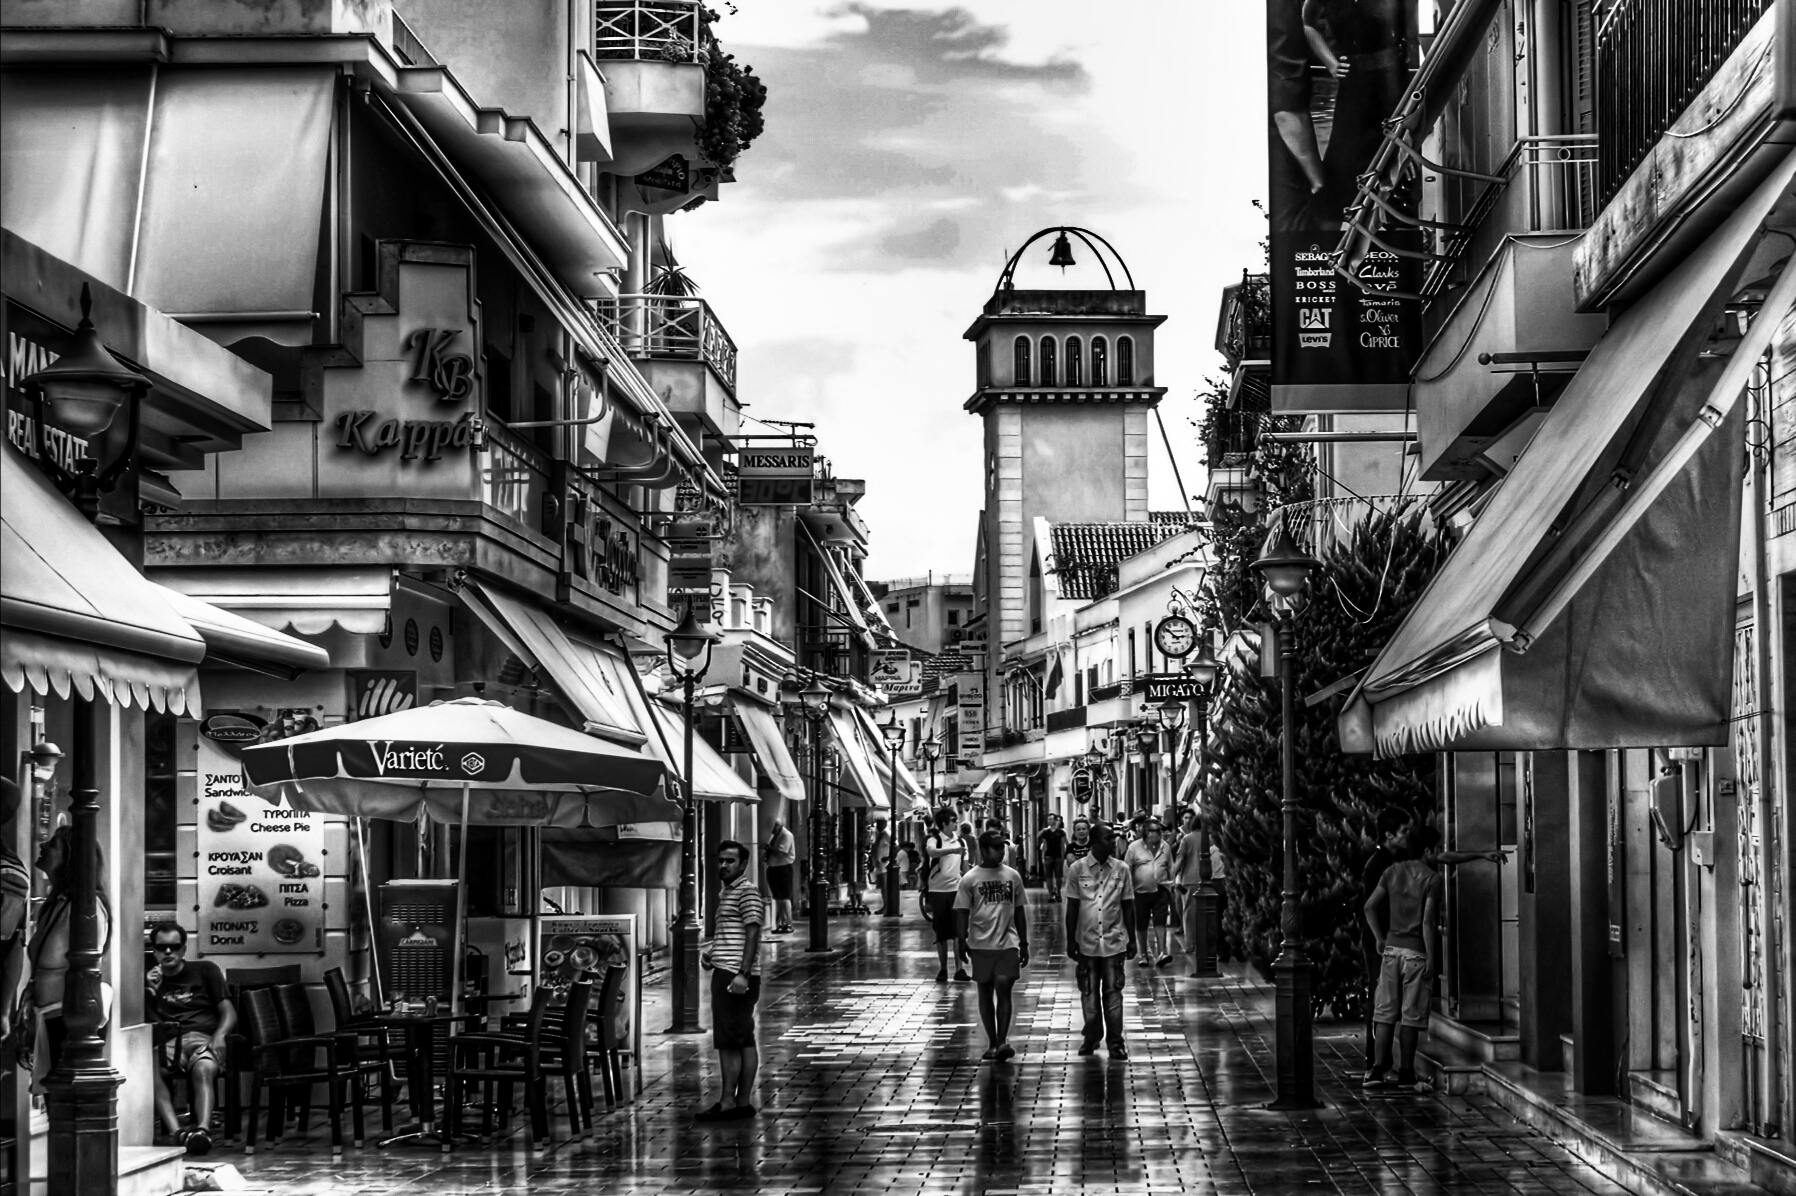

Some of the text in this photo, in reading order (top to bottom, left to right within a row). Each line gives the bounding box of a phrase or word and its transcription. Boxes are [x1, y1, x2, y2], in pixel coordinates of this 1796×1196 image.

[1294, 266, 1335, 277] Timberland
[1358, 265, 1400, 278] Clarks
[1295, 281, 1336, 290] BOSS
[1358, 298, 1401, 306] Tamaris
[1300, 308, 1332, 329] CAT
[1360, 308, 1399, 323] s.Oliver
[743, 454, 810, 469] MESSARIS
[359, 677, 414, 717] illy
[205, 773, 242, 786] ΣΑΝΤΟ
[204, 787, 253, 798] Sandwic
[250, 822, 311, 833] Cheese Pie
[208, 851, 263, 864] ΚΡΟΥΑΣΑΝ
[208, 865, 252, 876] Croisant
[279, 883, 309, 893] ΠΙΤΣΑ
[284, 896, 309, 907] Pizza
[210, 920, 259, 934] ΝΤΟΝΑΤΣ
[210, 934, 245, 946] Donut
